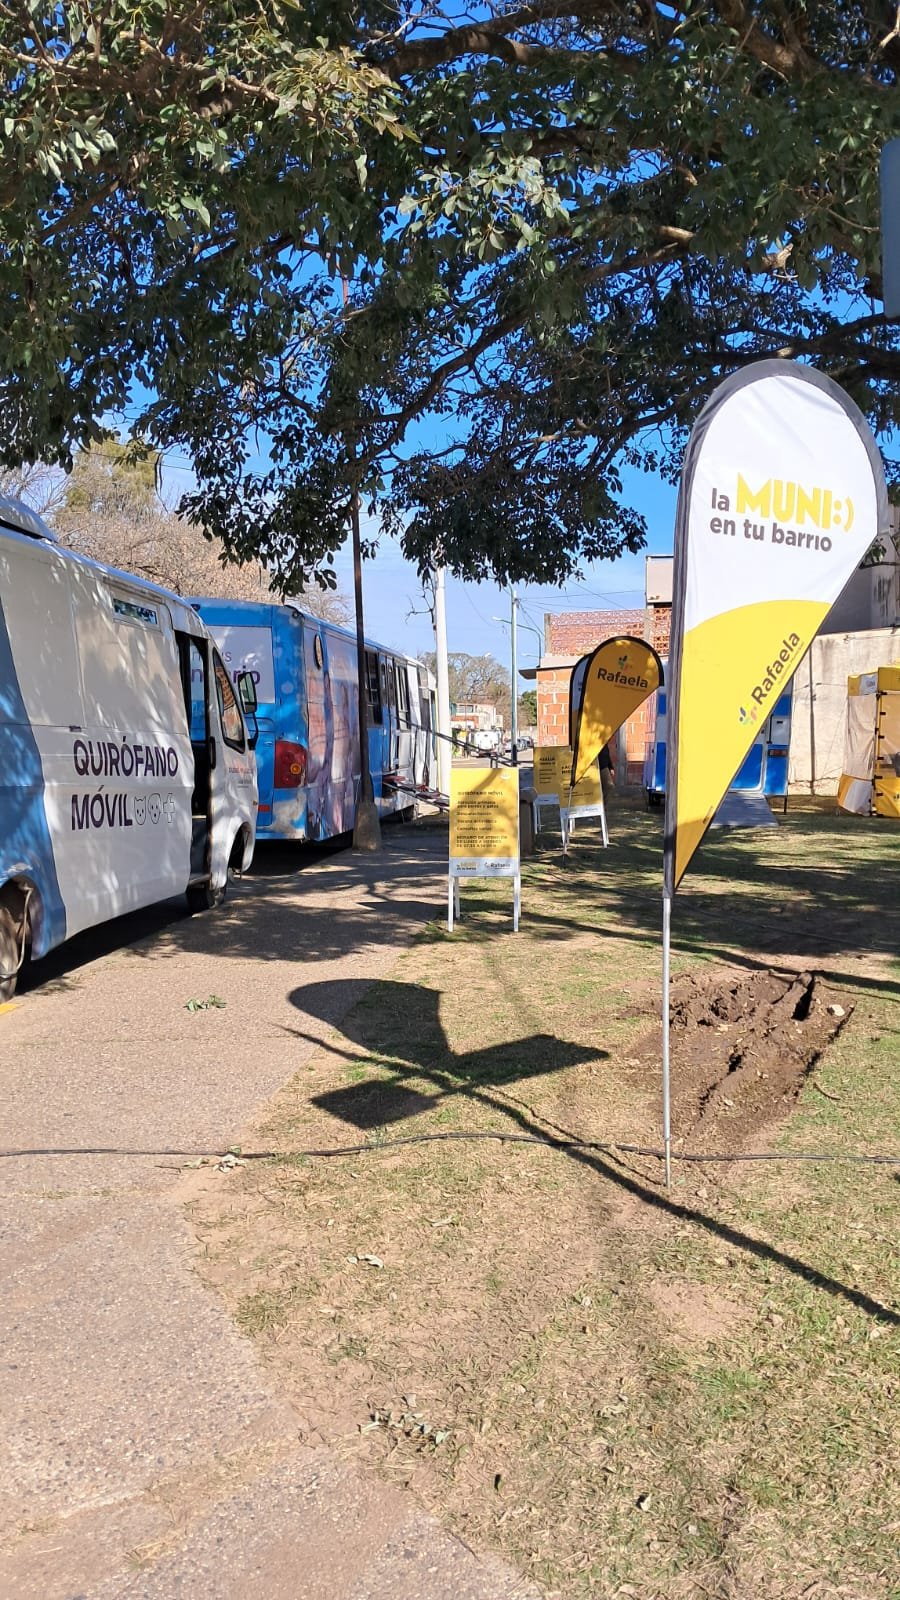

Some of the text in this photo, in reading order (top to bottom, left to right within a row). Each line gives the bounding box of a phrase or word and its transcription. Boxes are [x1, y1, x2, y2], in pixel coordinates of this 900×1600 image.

[711, 488, 730, 512] la
[710, 516, 832, 552] en tu barrio
[597, 667, 649, 688] Rafaela
[751, 632, 801, 705] Rafaela
[73, 736, 179, 777] QUIRÓFANO
[71, 784, 133, 831] MÓVIL
